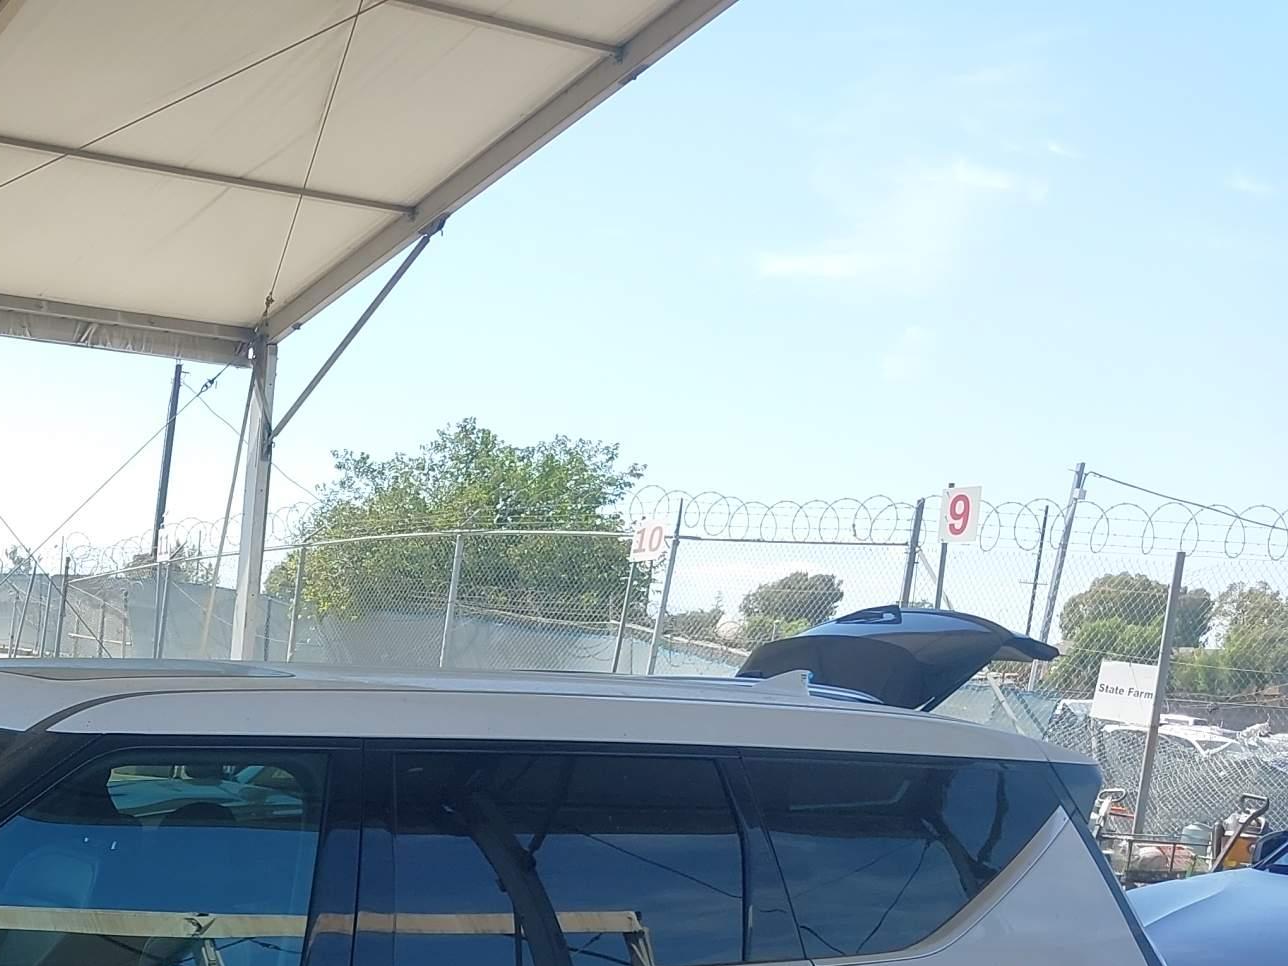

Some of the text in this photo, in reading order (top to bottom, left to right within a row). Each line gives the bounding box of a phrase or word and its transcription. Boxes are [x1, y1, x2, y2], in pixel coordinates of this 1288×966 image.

[949, 494, 970, 535] 9
[632, 526, 663, 553] 10
[1098, 683, 1154, 699] State Farm
